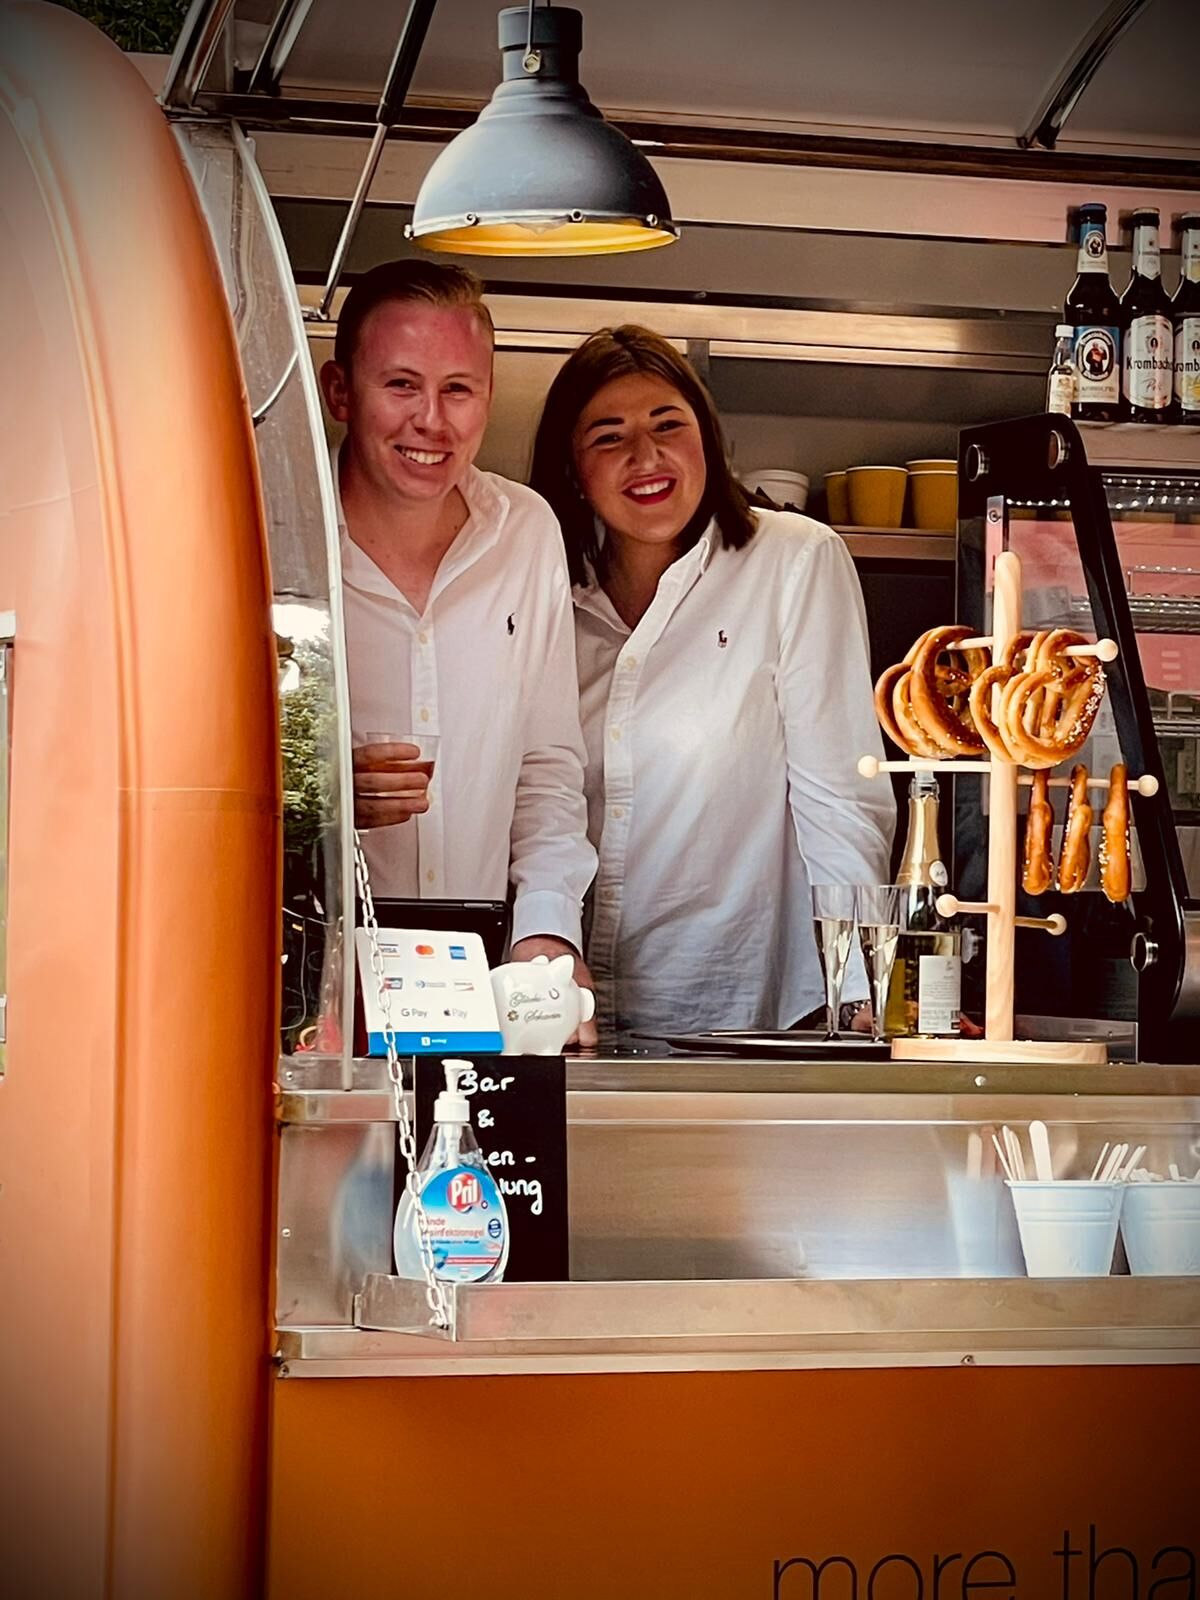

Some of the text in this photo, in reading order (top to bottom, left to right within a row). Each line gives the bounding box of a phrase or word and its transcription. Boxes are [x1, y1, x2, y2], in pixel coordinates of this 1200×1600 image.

[1173, 358, 1200, 372] romb
[412, 1008, 428, 1018] Pay
[452, 1008, 468, 1018] Pay
[459, 1070, 515, 1095] Bar
[477, 1109, 495, 1128] &
[450, 1176, 479, 1206] Pril
[773, 1524, 1200, 1600] more tha
